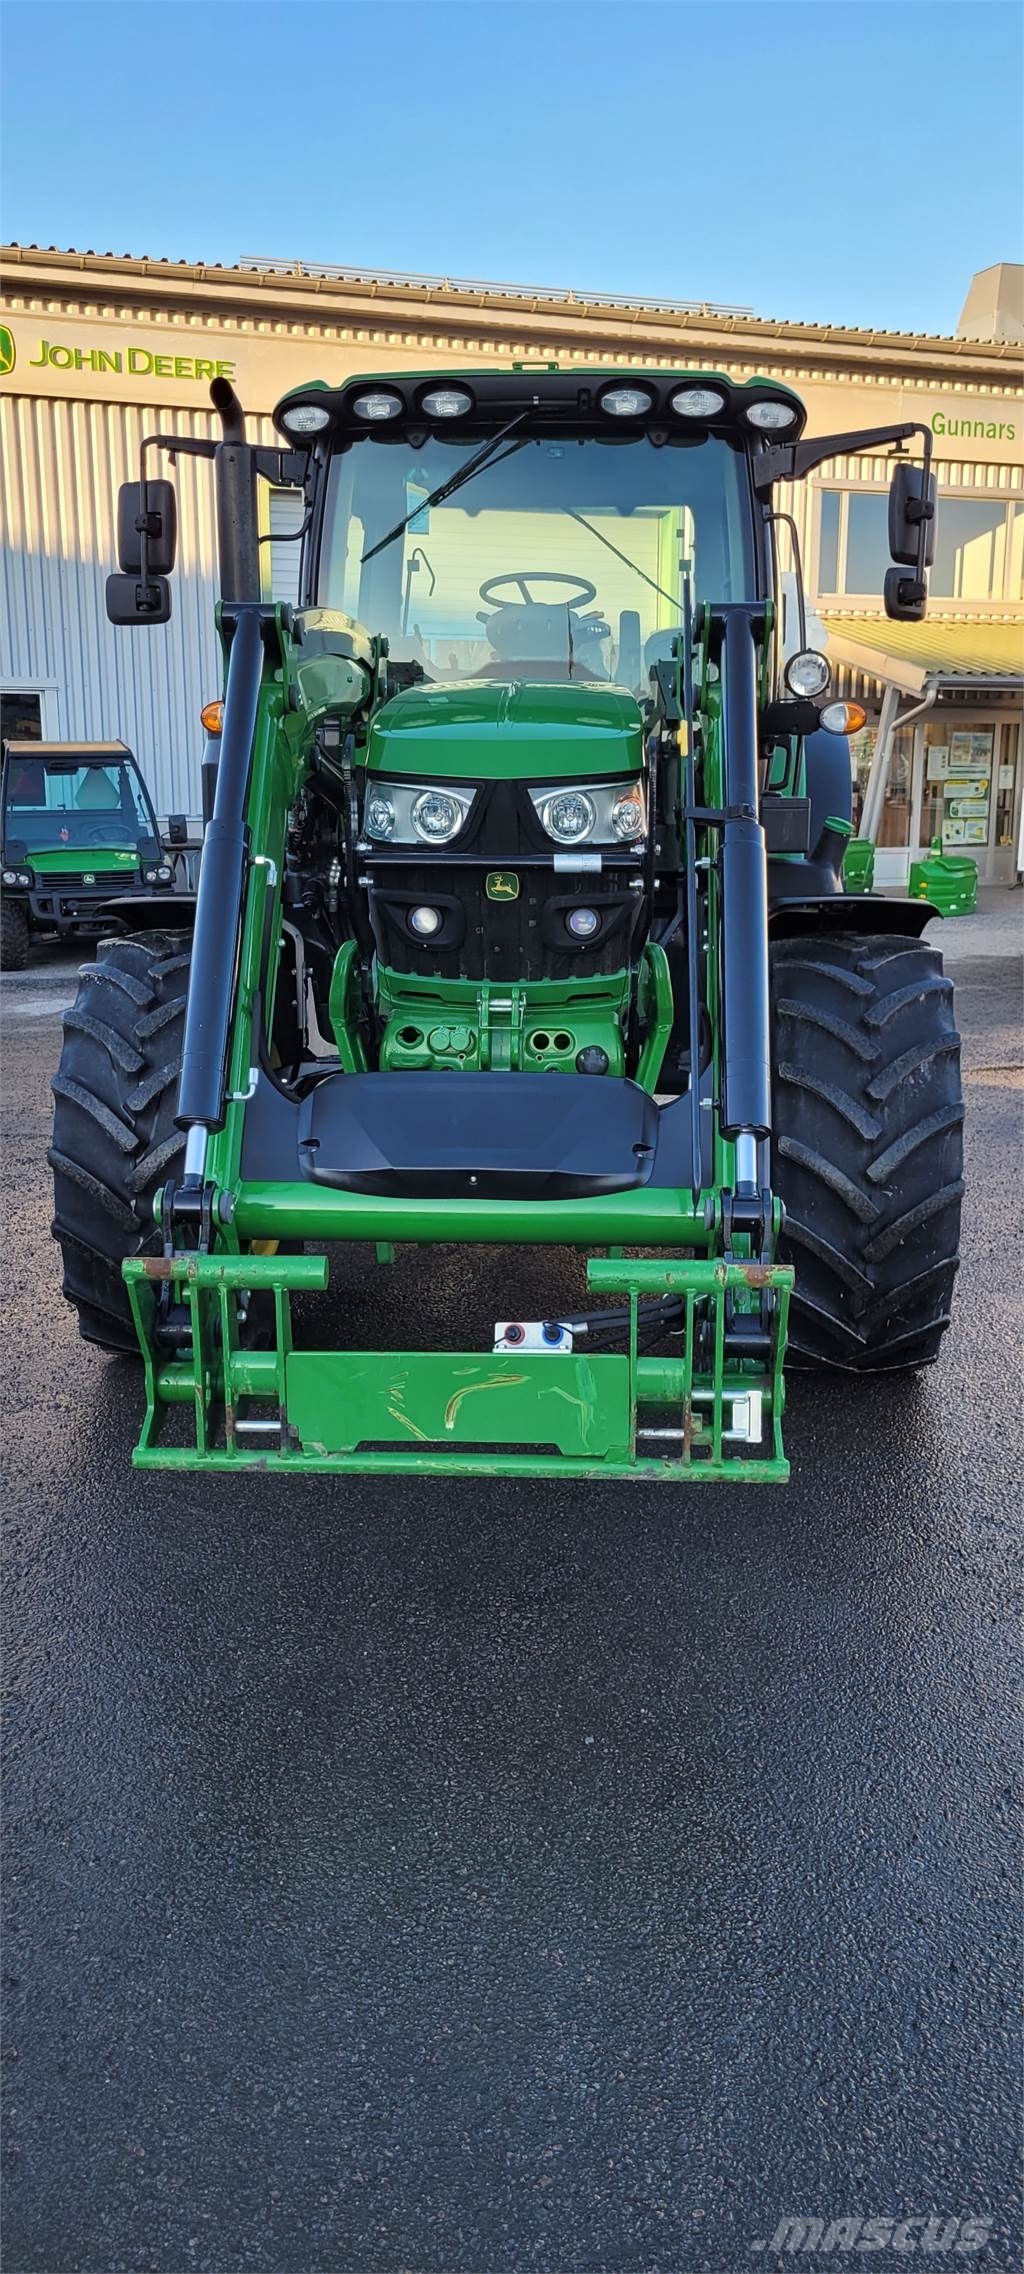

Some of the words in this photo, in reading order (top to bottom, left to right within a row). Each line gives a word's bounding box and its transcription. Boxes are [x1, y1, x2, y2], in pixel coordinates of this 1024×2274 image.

[29, 339, 121, 374] JOHN
[127, 347, 236, 383] DEERE
[931, 412, 1016, 440] Gunnars
